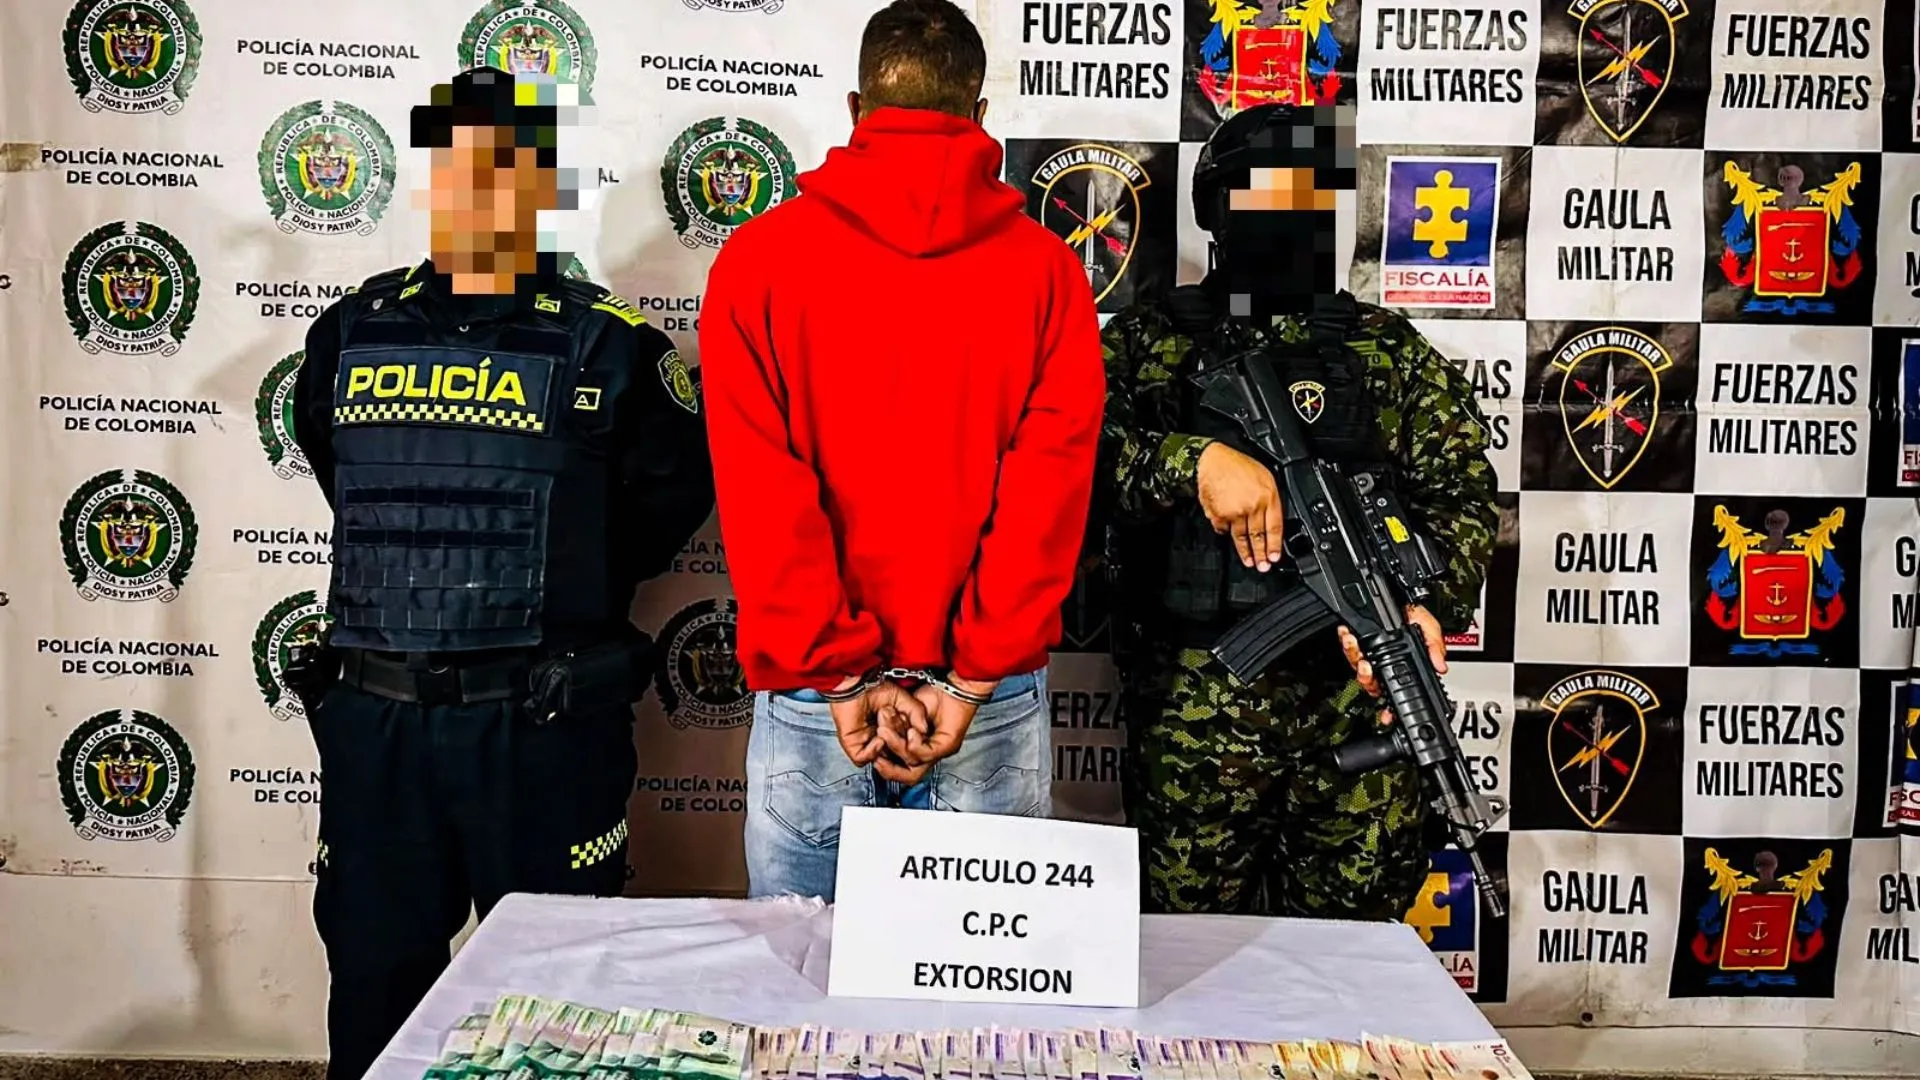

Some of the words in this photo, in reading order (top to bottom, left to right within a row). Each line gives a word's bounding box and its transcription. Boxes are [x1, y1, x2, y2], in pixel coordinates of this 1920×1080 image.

[1023, 2, 1171, 45] FUERZAS
[1376, 8, 1527, 51] FUERZAS
[1728, 14, 1870, 59] FUERZAS
[238, 39, 314, 56] POLICÍA
[320, 43, 419, 59] NACIONAL
[523, 8, 538, 16] DE
[548, 15, 580, 70] COLOMBIA
[264, 62, 287, 75] DE
[293, 63, 395, 78] COLOMBIA
[641, 54, 717, 72] POLICÍA
[723, 60, 823, 77] NACIONAL
[1020, 60, 1169, 99] MILITARES
[133, 67, 180, 97] NACIONAL
[667, 77, 692, 92] DE
[696, 79, 798, 97] COLOMBIA
[1371, 68, 1523, 103] MILITARES
[1721, 73, 1872, 110] MILITARES
[132, 96, 168, 110] PATRIA
[41, 148, 117, 164] POLICÍA
[123, 152, 223, 167] NACIONAL
[348, 123, 380, 176] COLOMBIA
[67, 171, 91, 184] DE
[97, 171, 198, 187] COLOMBIA
[751, 140, 781, 193] COLOMBIA
[1040, 149, 1086, 180] GAULA
[1087, 149, 1141, 181] MILITAR
[327, 189, 375, 218] NACIONAL
[1564, 188, 1671, 229] GAULA
[327, 217, 362, 231] PATRIA
[125, 236, 140, 244] DE
[151, 244, 182, 297] COLOMBIA
[1385, 268, 1489, 286] FISCALÍA
[1558, 247, 1673, 281] MILITAR
[236, 281, 311, 298] POLICÍA
[640, 295, 700, 311] POLICÍ
[131, 309, 177, 339] NACIONAL
[261, 304, 285, 317] DE
[664, 318, 688, 331] DE
[131, 338, 166, 352] PATRIA
[1561, 333, 1606, 363] GAULA
[1608, 331, 1661, 363] MILITAR
[273, 370, 298, 419] REPUBLIC
[346, 356, 526, 406] POLICÍA
[1712, 364, 1857, 405] FUERZAS
[40, 394, 115, 411] POLICÍA
[121, 399, 221, 414] NACIONAL
[65, 417, 89, 430] DE
[95, 418, 196, 433] COLOMBIA
[1709, 419, 1857, 455] MILITARES
[123, 484, 138, 492] DE
[149, 491, 181, 544] COLOMBIA
[234, 528, 308, 544] POLICÍA
[259, 550, 282, 563] DE
[1555, 533, 1657, 573] GAULA
[128, 556, 175, 585] NACIONAL
[128, 584, 164, 598] PATRIA
[1547, 589, 1659, 624] MILITAR
[38, 637, 113, 654] POLICÍA
[120, 642, 219, 657] NACIONAL
[62, 660, 86, 673] DE
[93, 660, 194, 676] COLOMBIA
[1549, 675, 1594, 705] GAULA
[1596, 675, 1650, 705] MILITAR
[286, 702, 304, 715] DIO
[1700, 705, 1845, 746] FUERZAS
[121, 724, 135, 732] DE
[147, 731, 178, 784] COLOMBIA
[230, 767, 305, 784] POLICÍA
[637, 775, 711, 792] POLICÍA
[1697, 761, 1844, 798] MILITARES
[126, 795, 173, 825] NACIONAL
[255, 790, 278, 803] DE
[661, 798, 685, 811] DE
[690, 798, 743, 812] COLO
[125, 823, 161, 838] PATRIA
[900, 856, 1036, 884] ARTICULO
[1045, 863, 1094, 888] 244
[1543, 870, 1648, 914] GAULA
[963, 911, 1027, 938] C.P.C
[1538, 928, 1648, 963] MILITAR
[914, 963, 1072, 993] EXTORSION
